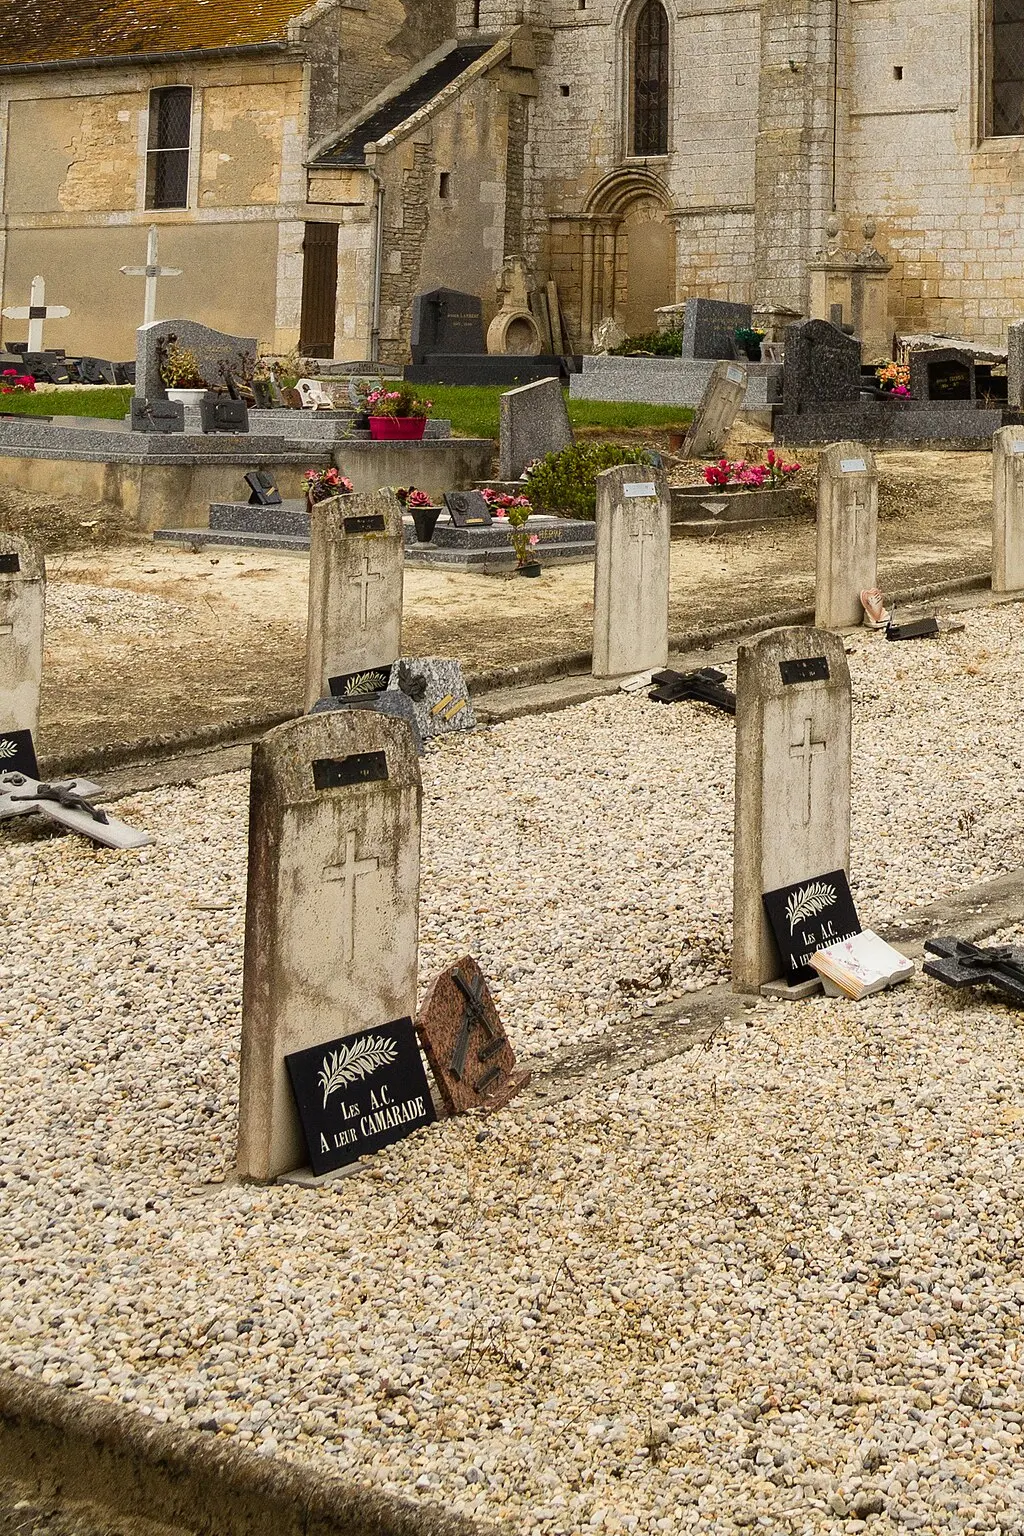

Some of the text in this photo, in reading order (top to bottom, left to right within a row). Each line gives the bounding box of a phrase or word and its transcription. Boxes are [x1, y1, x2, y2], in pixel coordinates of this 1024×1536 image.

[820, 920, 838, 939] A.C.
[790, 953, 799, 970] A
[370, 1085, 395, 1110] A.C.
[320, 1096, 426, 1154] A LEUR CAMARADE
